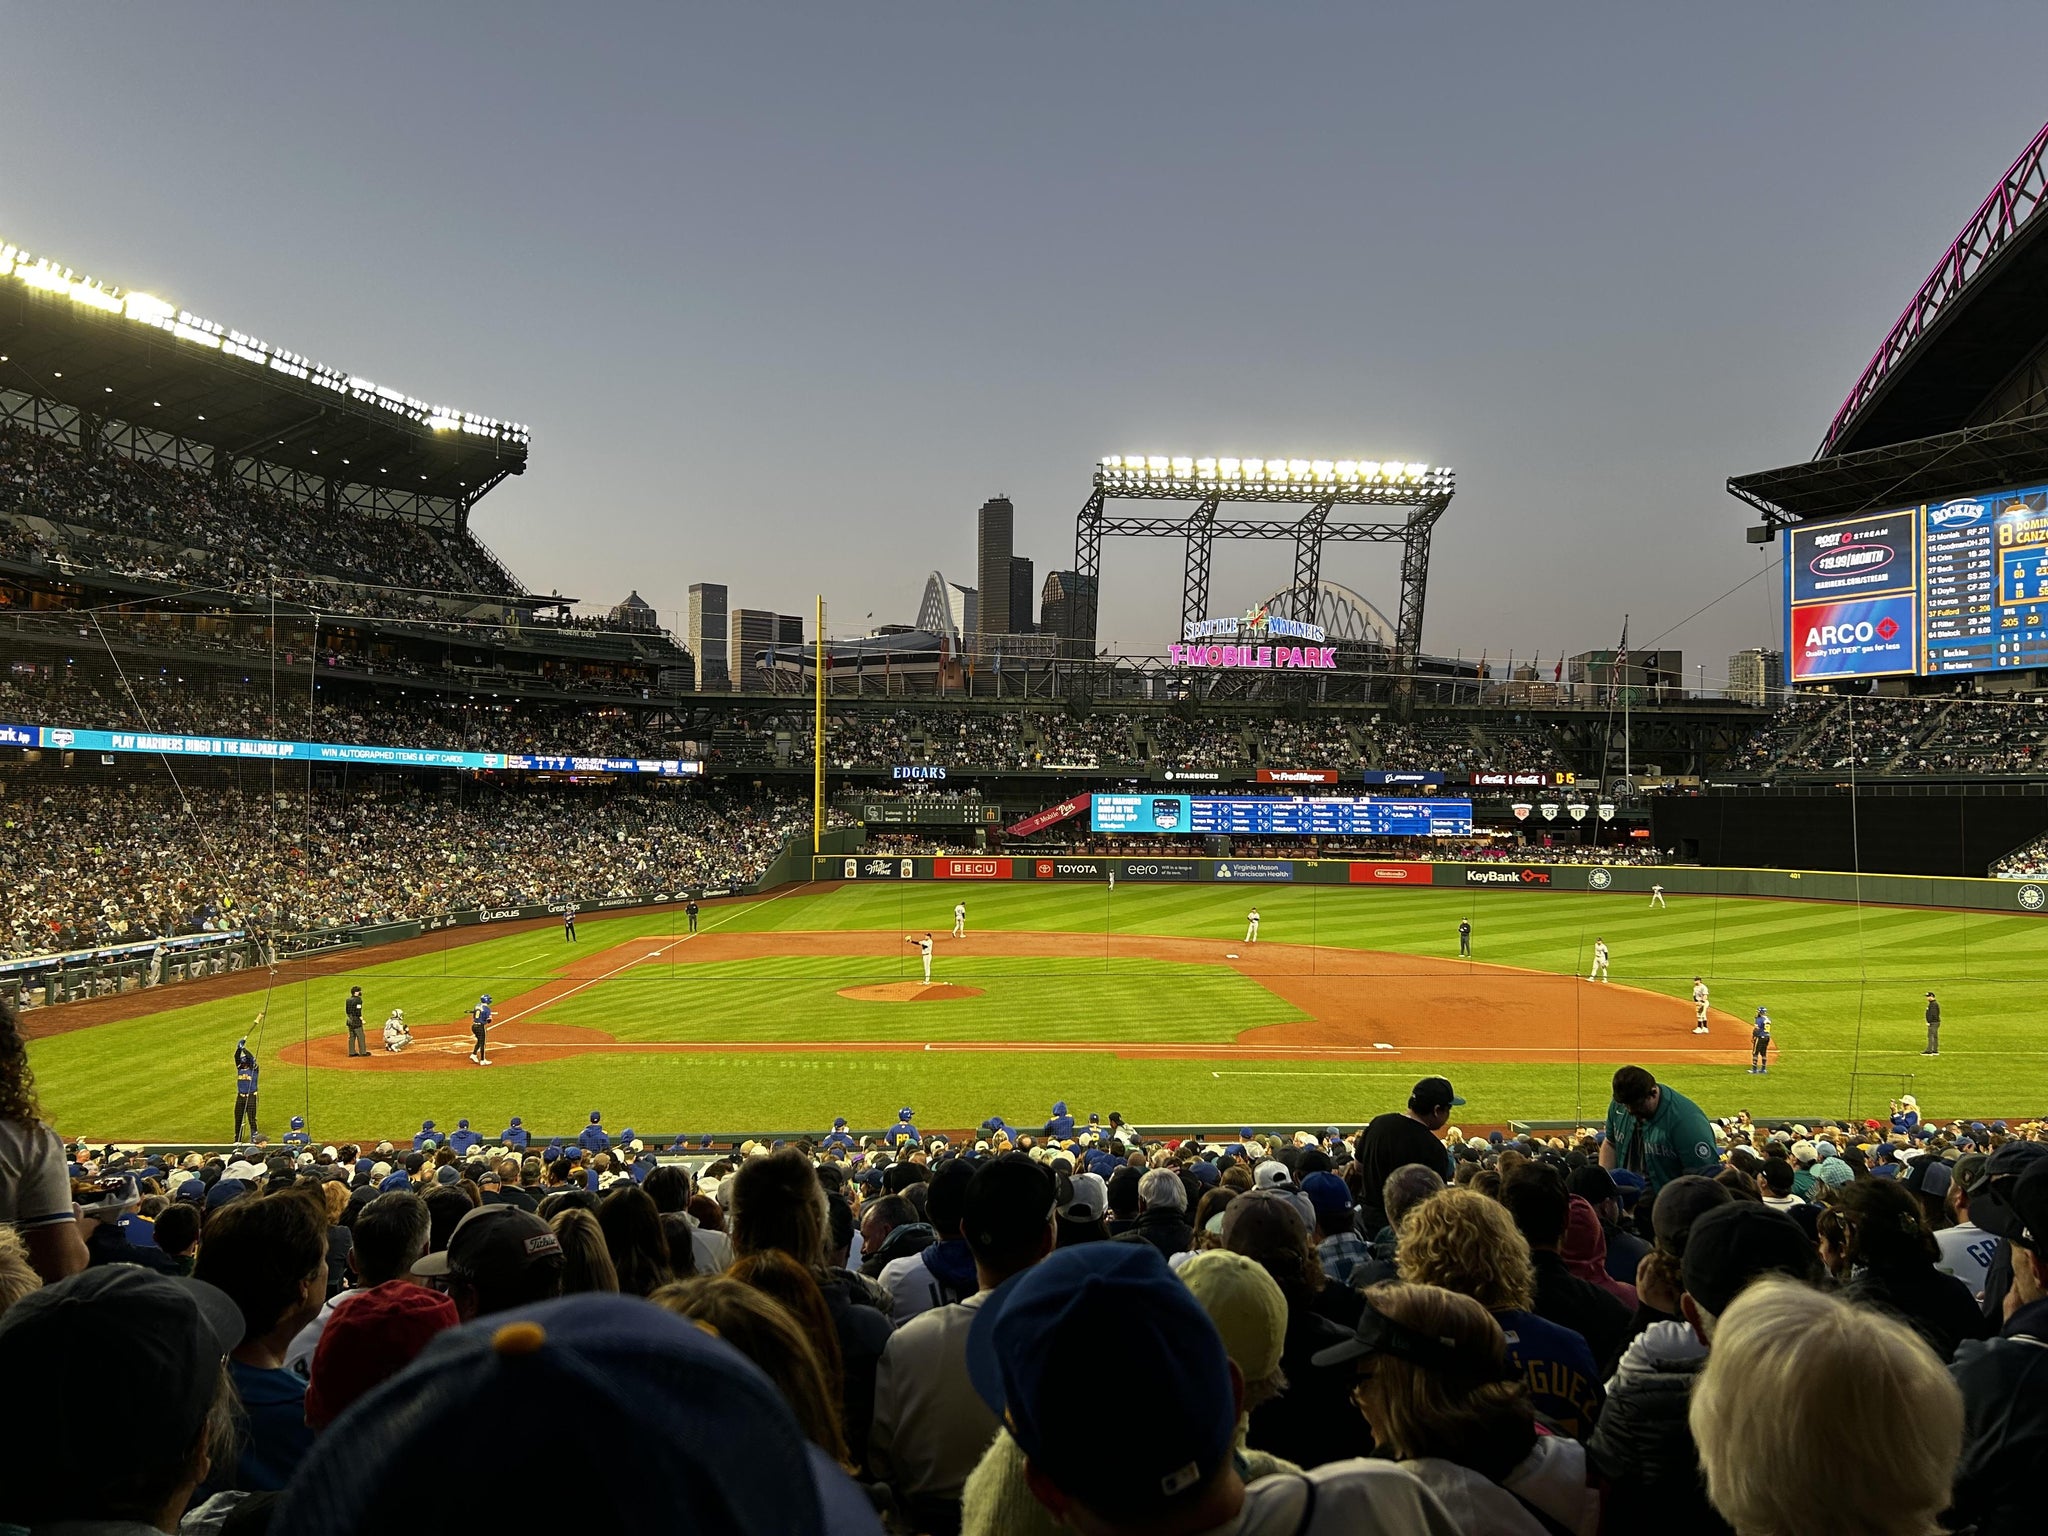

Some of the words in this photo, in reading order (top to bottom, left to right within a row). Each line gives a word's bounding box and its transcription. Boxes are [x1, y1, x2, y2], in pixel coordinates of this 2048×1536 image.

[1930, 504, 1985, 525] ROCKIES
[1815, 533, 1842, 545] ROOT
[1853, 529, 1888, 540] STREAM
[2000, 524, 2012, 546] 8
[1937, 542, 1967, 551] Goodman
[2001, 618, 2018, 627] .305
[1183, 617, 1239, 641] SEATTLE
[1268, 616, 1326, 642] MARINERS
[1805, 621, 1874, 647] ARCO
[1168, 644, 1272, 668] T-MOBILE
[1276, 647, 1337, 668] PARK
[112, 735, 135, 748] PLAY
[136, 736, 184, 752] MARINERS
[185, 739, 211, 752] BINGO
[223, 741, 239, 754] THE
[239, 742, 278, 756] BALLPARK
[278, 744, 294, 756] APP
[321, 748, 338, 757] WIN
[339, 749, 395, 761] AUTOGRAPHED
[396, 752, 418, 762] ITEMS
[425, 754, 440, 763] GIFT
[441, 754, 464, 764] CARDS
[572, 757, 608, 765] FOUR-SEAM
[574, 762, 605, 771] FASTBALL
[1176, 772, 1219, 780] STARBUCKS
[954, 864, 994, 873] BECU
[1056, 864, 1098, 874] TOYOTA
[1128, 864, 1158, 875] eero
[1233, 864, 1256, 872] Virginia
[1376, 870, 1406, 878] Nintendo
[1467, 871, 1520, 884] KeyBank
[548, 904, 566, 912] Great
[490, 910, 520, 919] LEXUS
